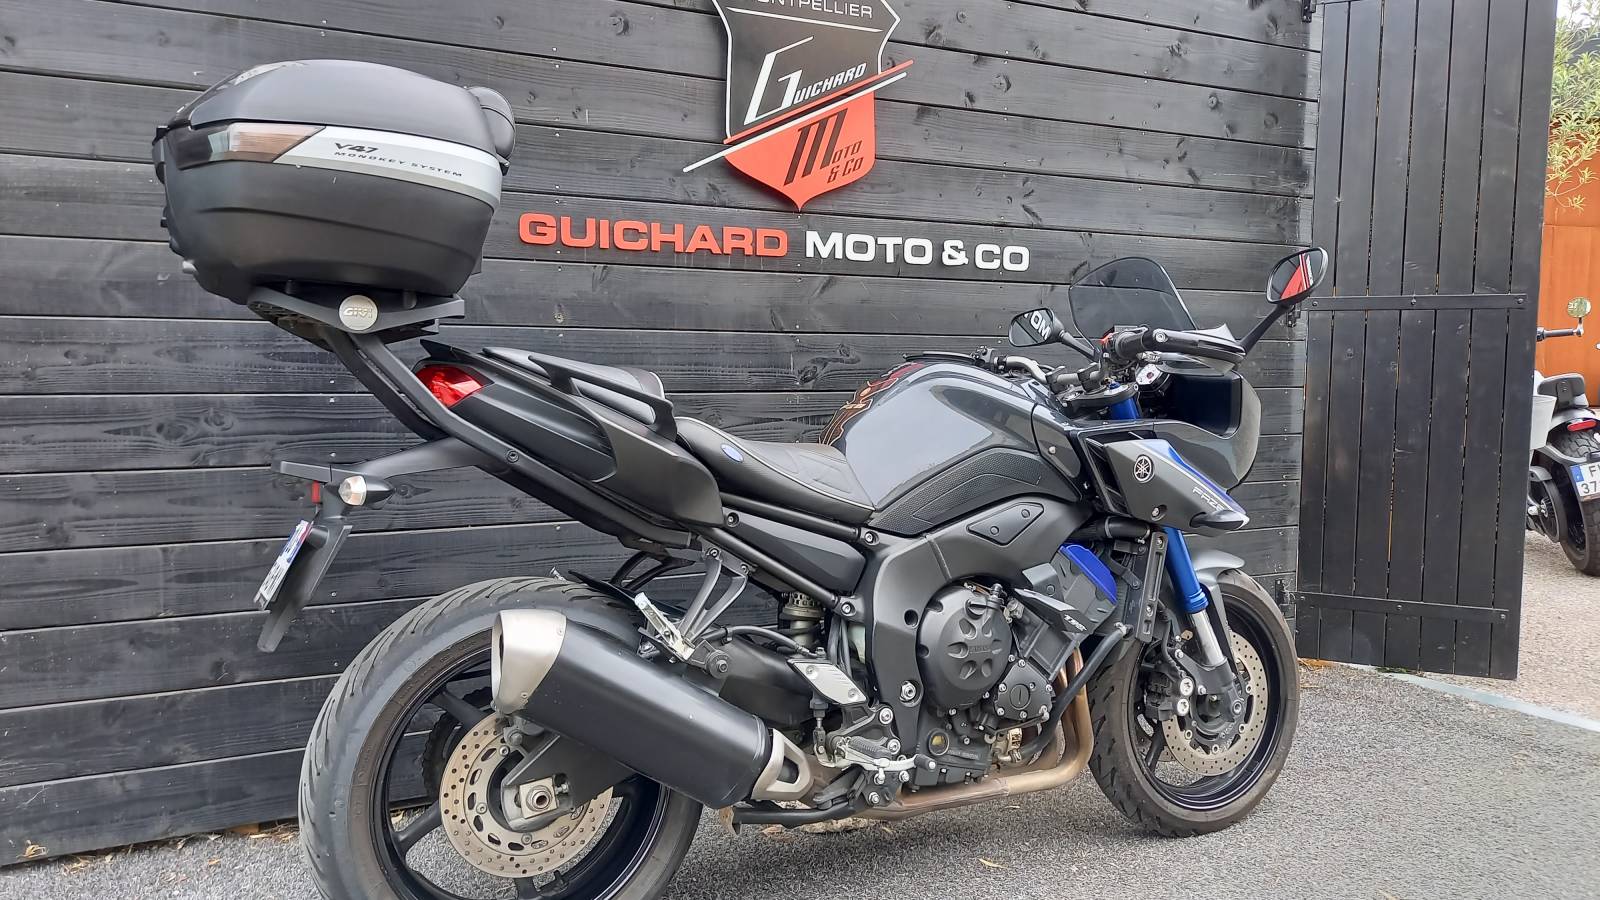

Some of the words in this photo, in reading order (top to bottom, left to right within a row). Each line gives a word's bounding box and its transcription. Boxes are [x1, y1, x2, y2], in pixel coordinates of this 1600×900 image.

[758, 0, 873, 19] TPELLIER
[335, 142, 379, 154] V47
[334, 151, 406, 165] MONOKEY
[411, 162, 463, 177] SYSTEM
[518, 212, 788, 258] GUICHARD
[805, 230, 933, 266] MOTO
[941, 239, 969, 267] &
[974, 243, 1030, 272] CO
[1192, 486, 1225, 511] FAZE
